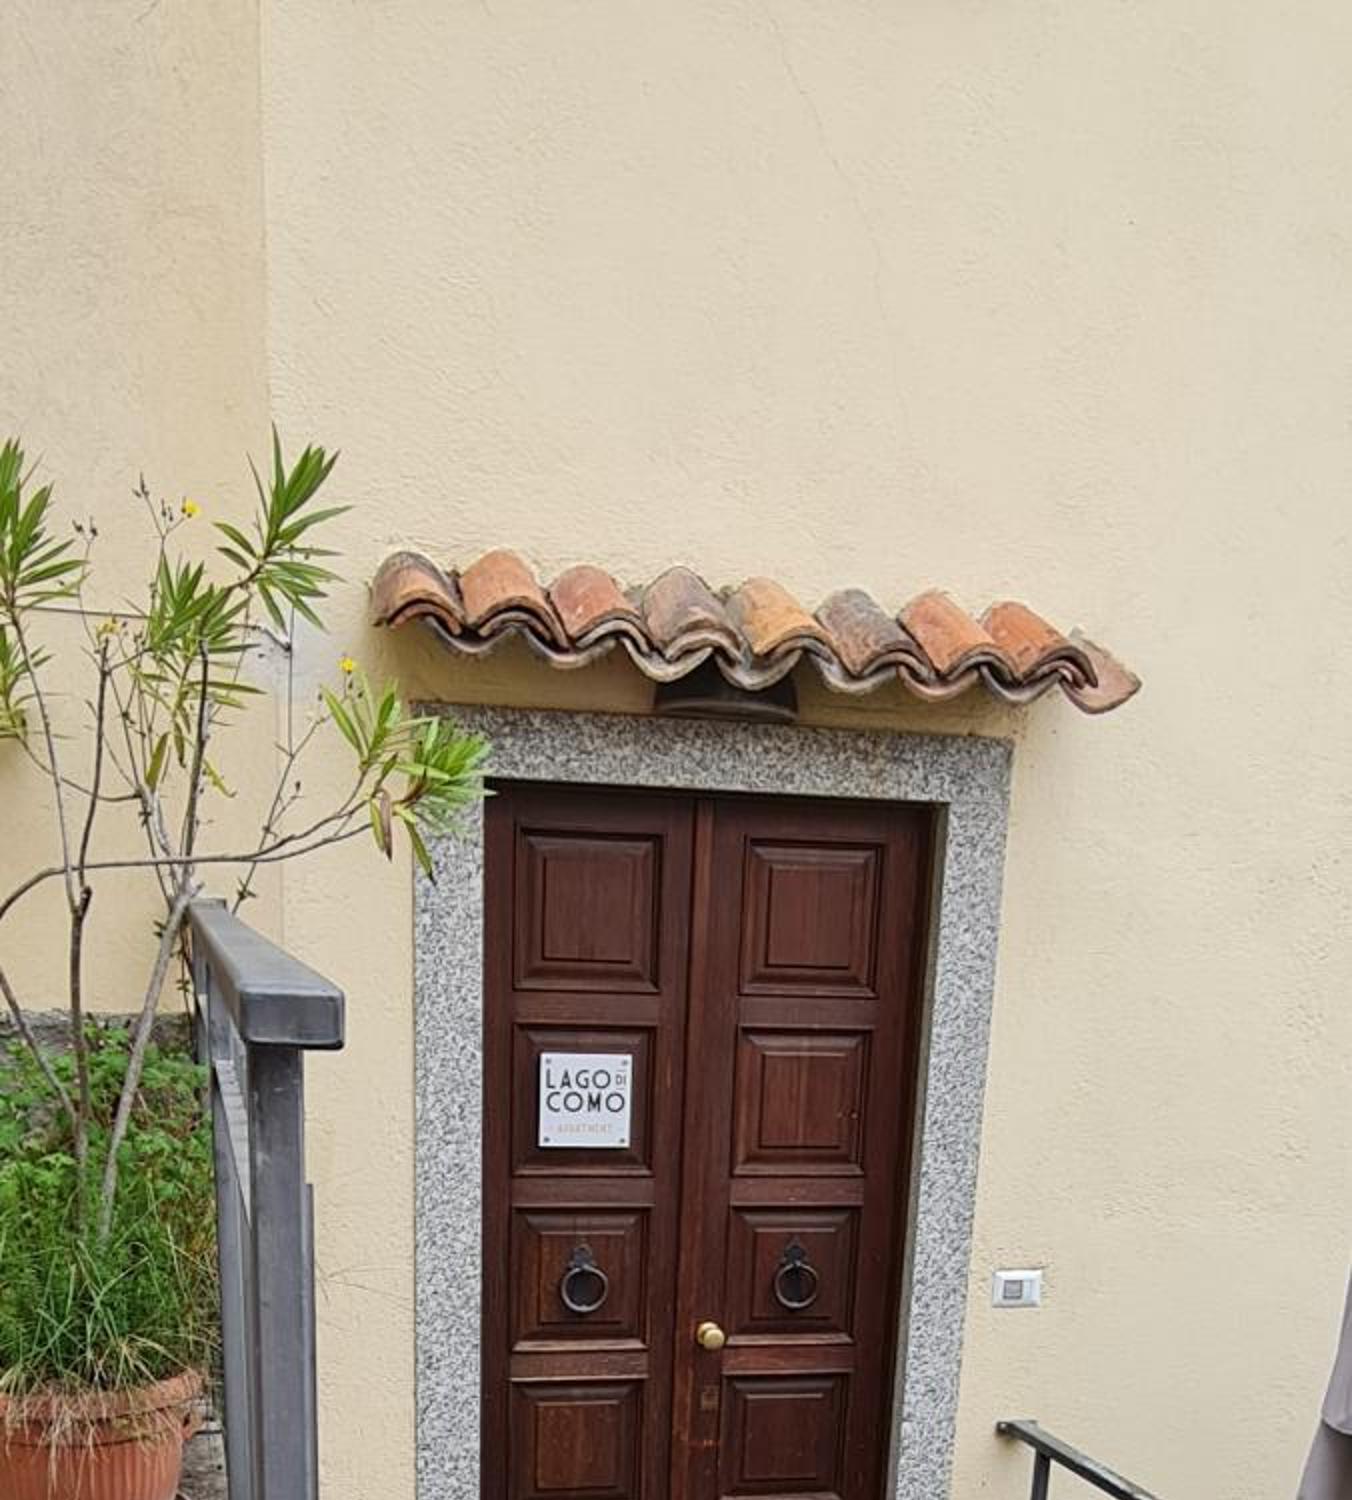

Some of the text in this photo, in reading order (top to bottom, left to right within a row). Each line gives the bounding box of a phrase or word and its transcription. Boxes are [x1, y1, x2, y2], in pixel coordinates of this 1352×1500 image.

[546, 1068, 626, 1089] LAGO DI
[546, 1091, 625, 1113] COMO
